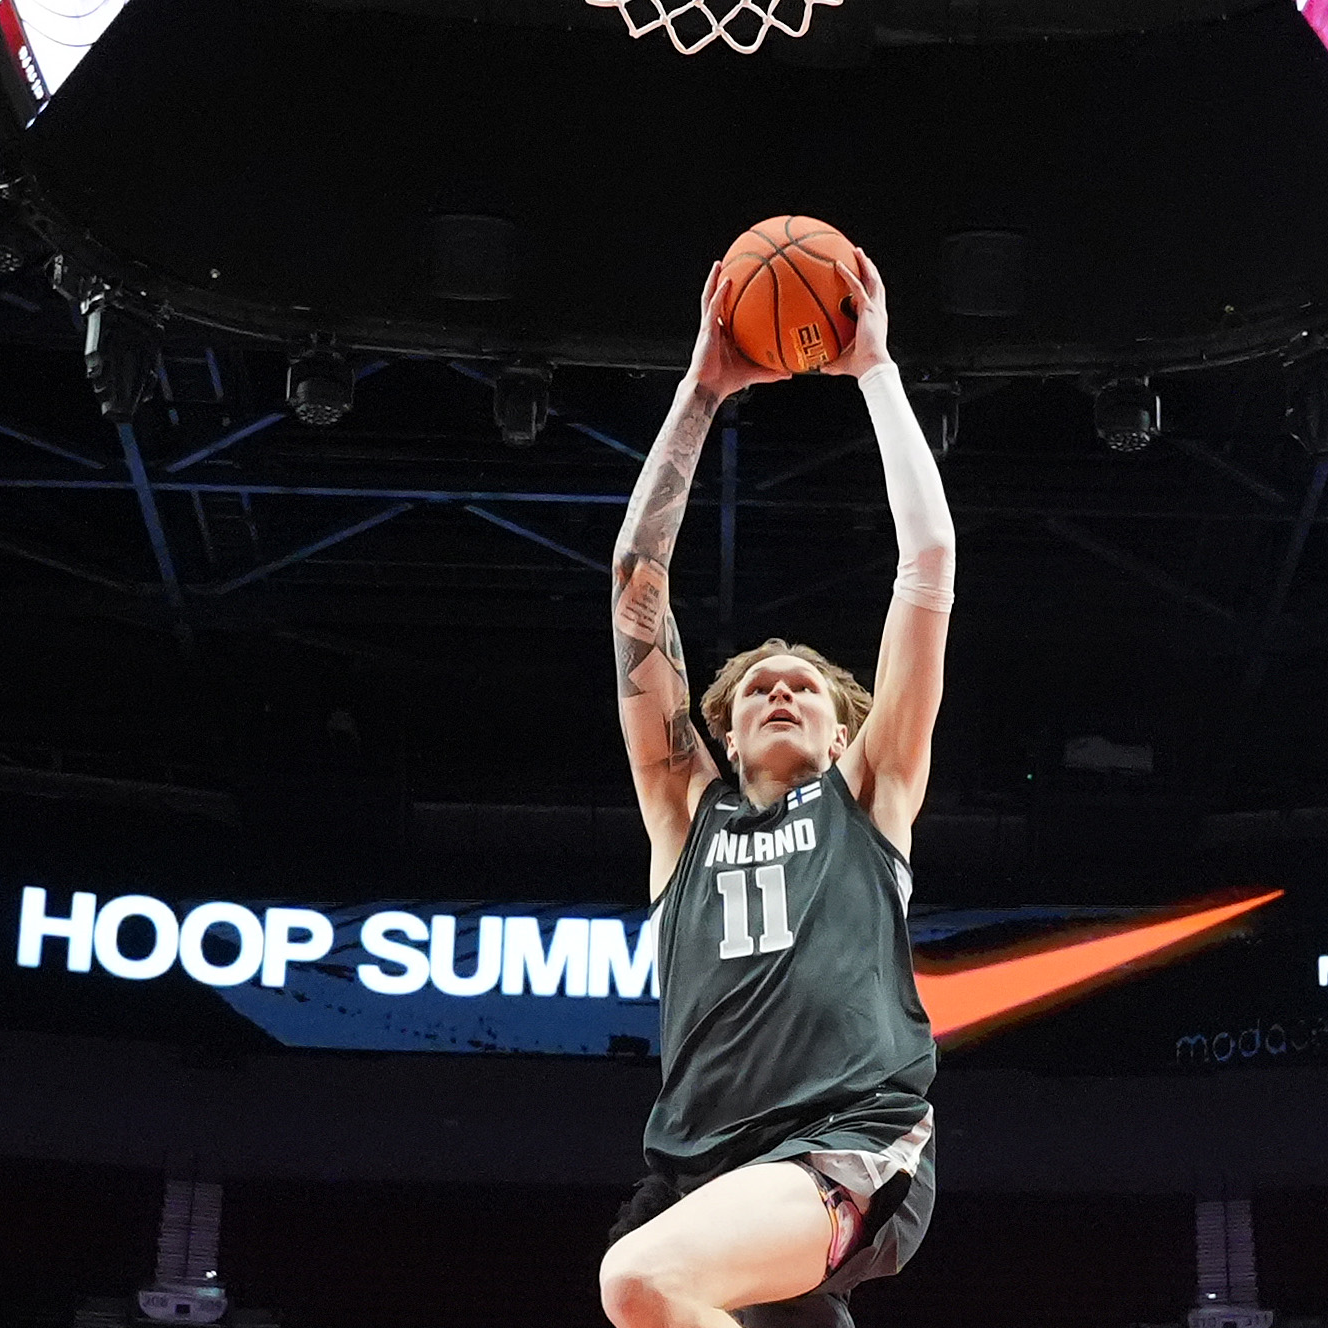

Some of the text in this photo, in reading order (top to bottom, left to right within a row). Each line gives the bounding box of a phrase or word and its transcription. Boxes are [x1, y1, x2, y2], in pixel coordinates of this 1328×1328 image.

[17, 886, 335, 988] HOOP
[356, 898, 661, 1000] SUMM
[717, 864, 795, 960] 11
